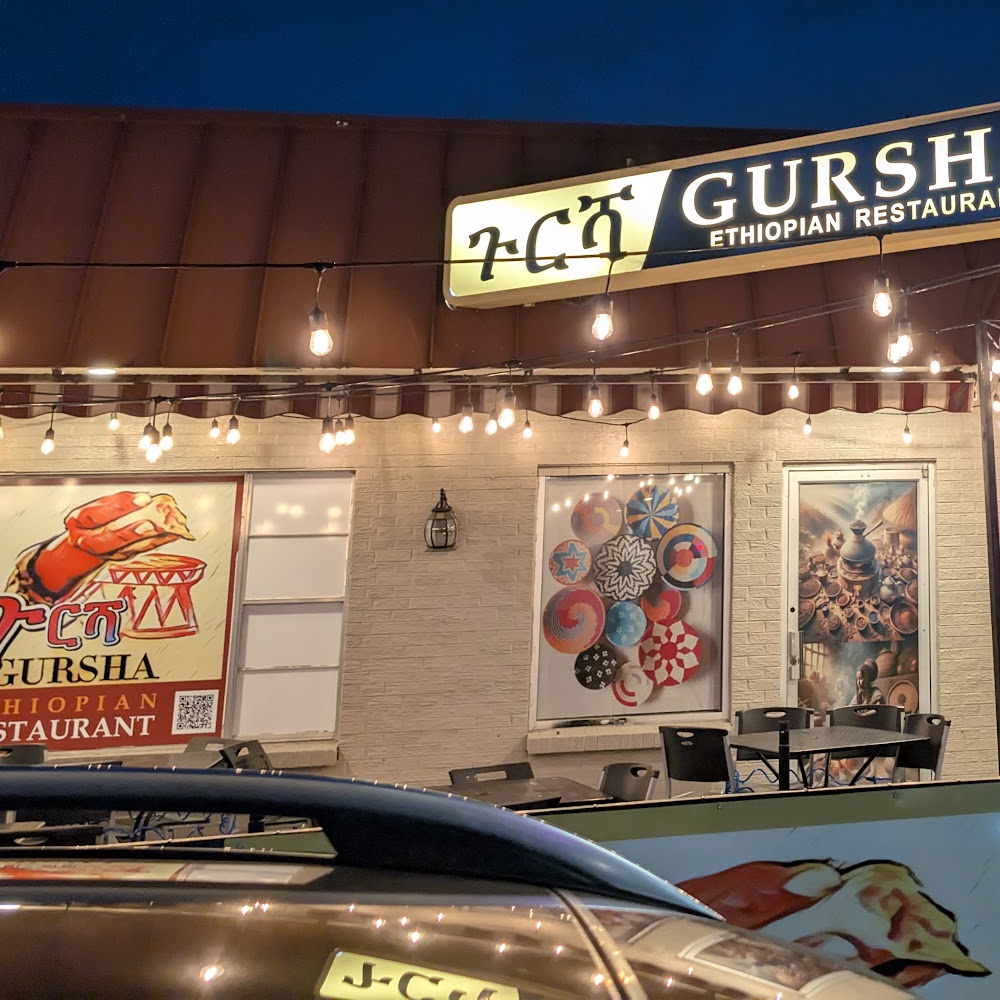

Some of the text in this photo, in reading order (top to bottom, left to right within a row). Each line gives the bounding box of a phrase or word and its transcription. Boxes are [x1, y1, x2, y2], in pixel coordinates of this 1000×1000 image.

[468, 178, 634, 281] ጉርሻ
[710, 212, 840, 247] ETHIOPIAN
[0, 652, 160, 687] GURSHA
